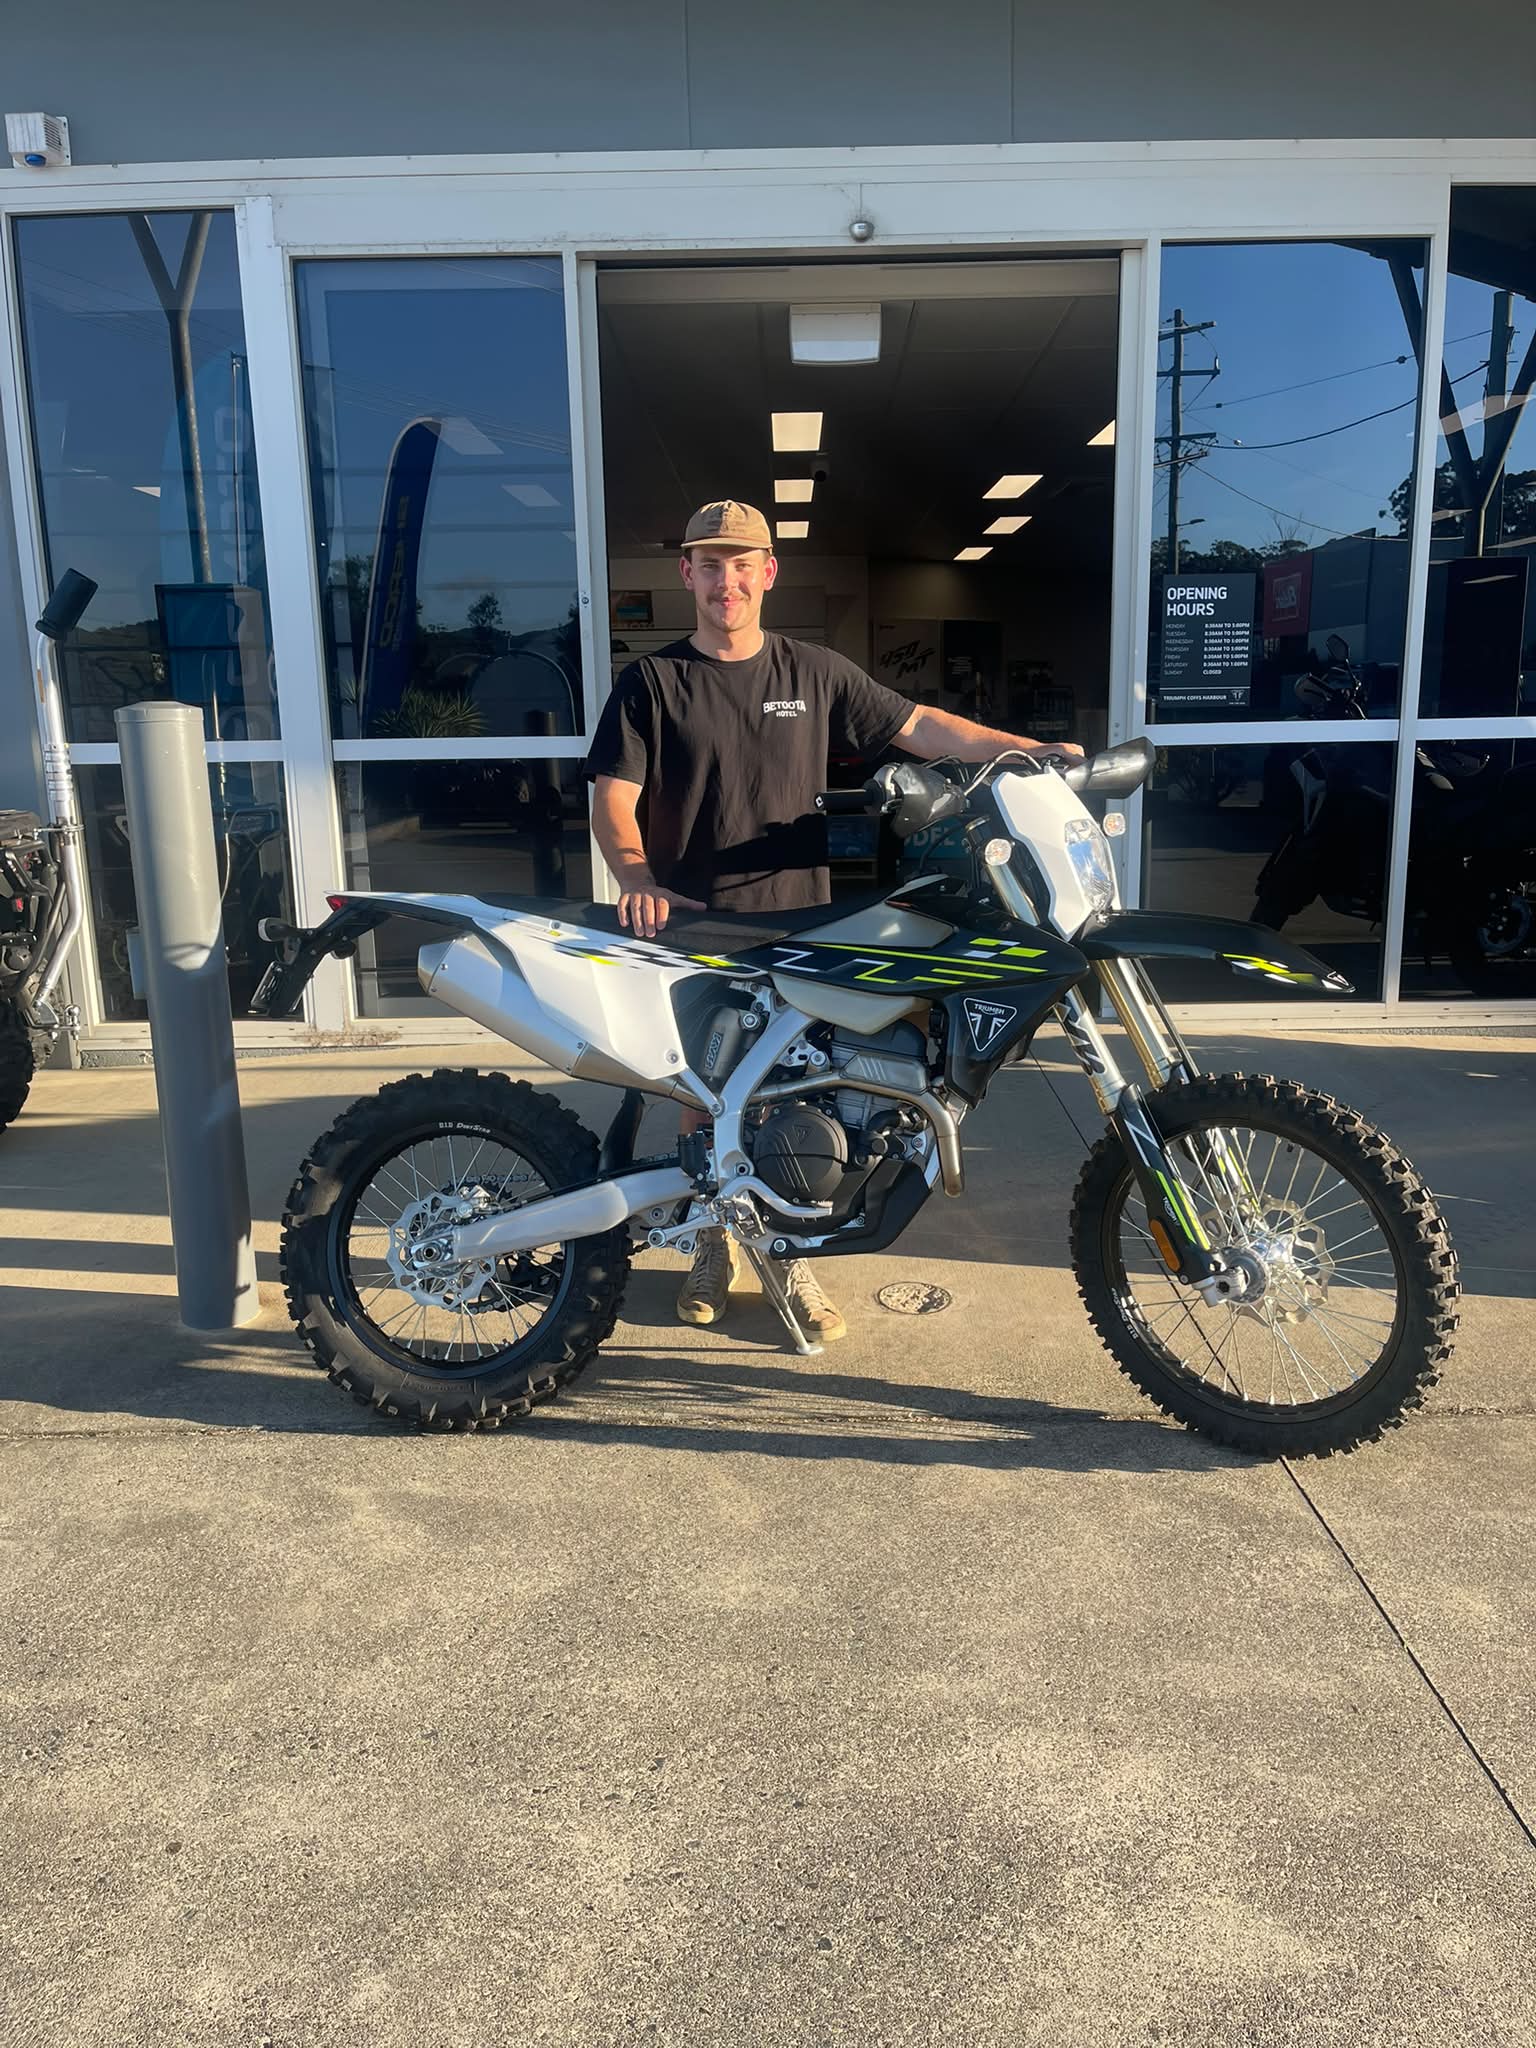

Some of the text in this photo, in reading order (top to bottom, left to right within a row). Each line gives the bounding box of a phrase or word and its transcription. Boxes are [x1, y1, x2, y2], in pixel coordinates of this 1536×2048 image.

[1167, 586, 1227, 600] OPENING
[1167, 603, 1215, 616] HOURS
[763, 700, 806, 713] BETOOTA
[974, 1002, 1005, 1016] TRIUMPH
